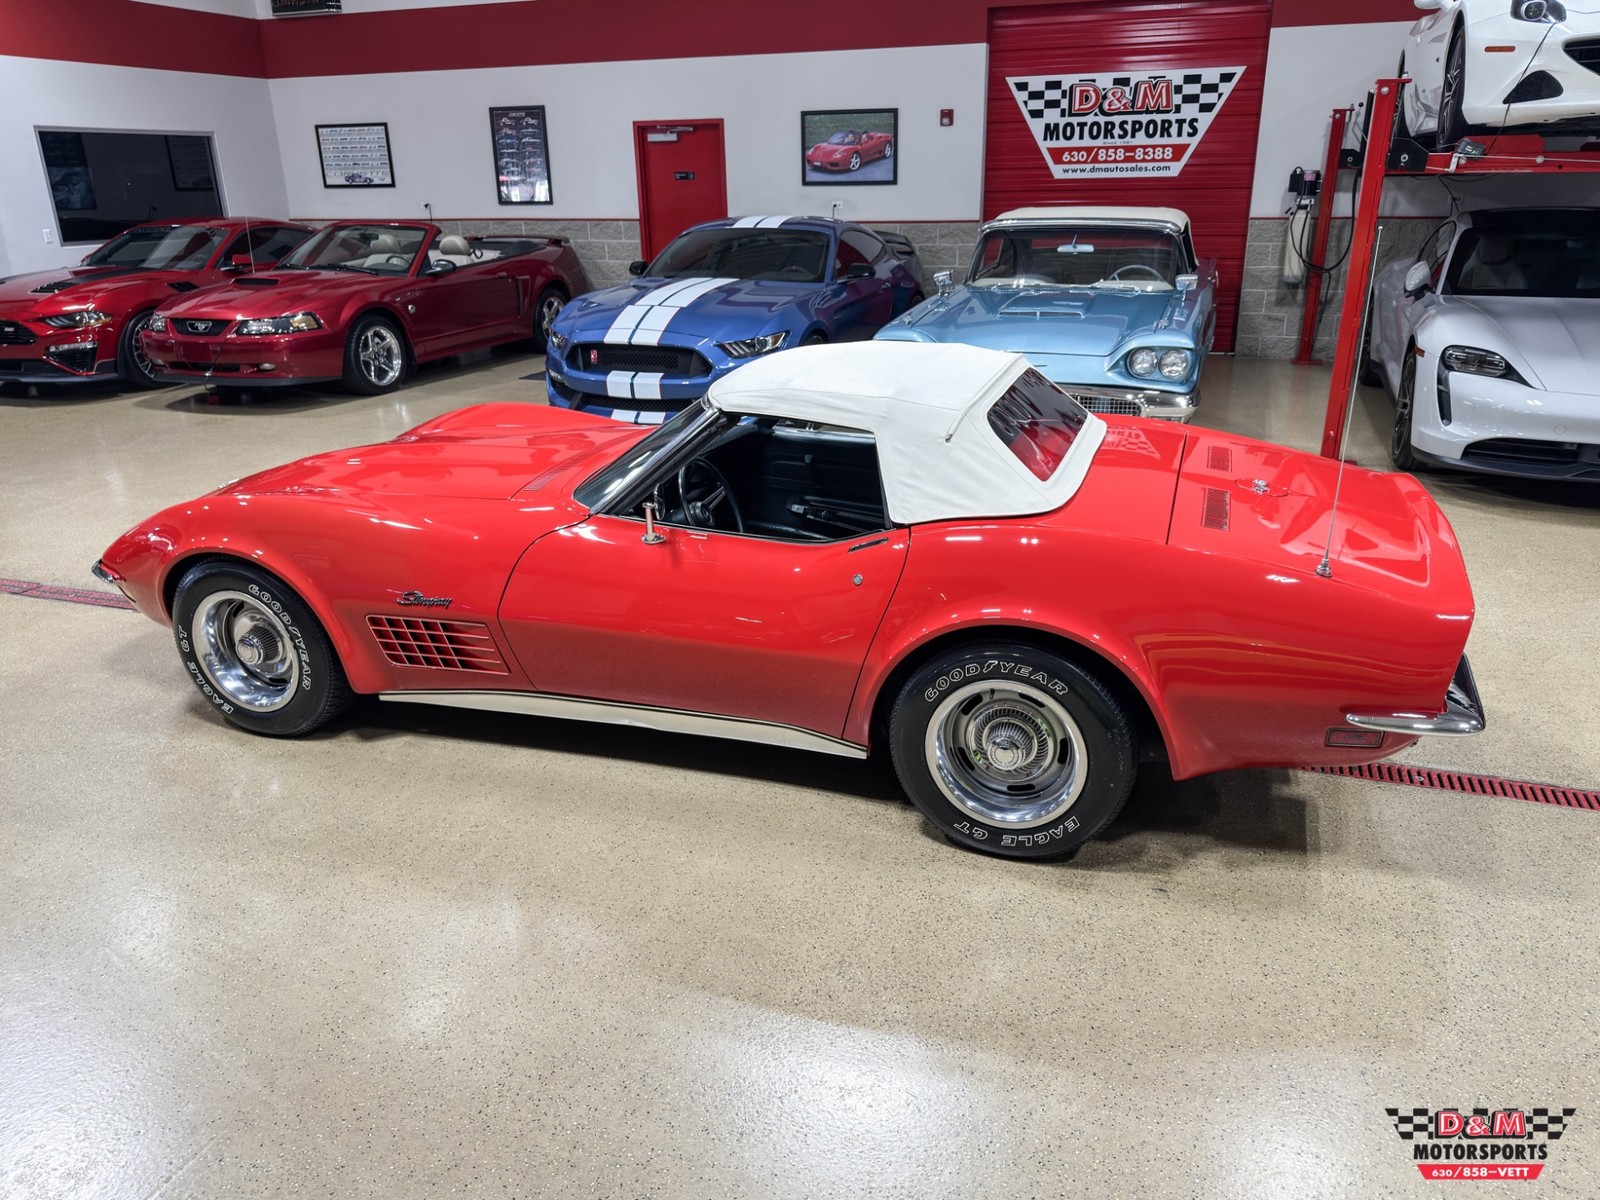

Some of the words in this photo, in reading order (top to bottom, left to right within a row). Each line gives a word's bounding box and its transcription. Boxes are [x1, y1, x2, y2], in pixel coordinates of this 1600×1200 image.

[1069, 79, 1174, 117] D&M
[1043, 118, 1199, 142] MOTORSPORTS
[1062, 147, 1173, 162] 630/858-8388
[1062, 163, 1171, 174] www.dmautosales.com
[396, 590, 453, 609] Stingray
[178, 625, 190, 652] GT
[248, 584, 312, 690] GOODYEAR
[187, 661, 234, 714] EAGLE
[925, 660, 1069, 701] GOODYEAR
[954, 821, 988, 840] GT
[1001, 816, 1080, 847] EAGLE
